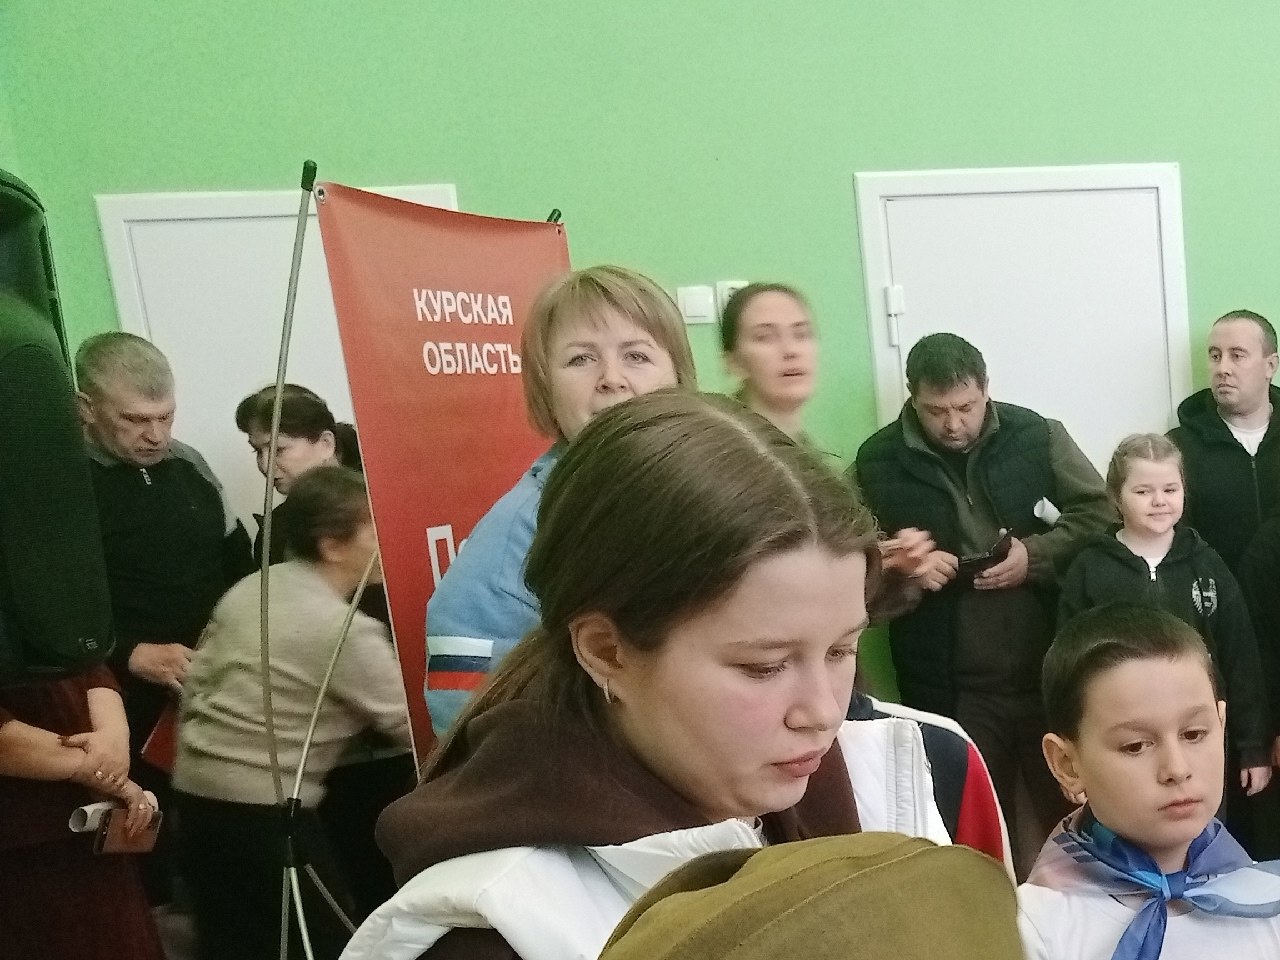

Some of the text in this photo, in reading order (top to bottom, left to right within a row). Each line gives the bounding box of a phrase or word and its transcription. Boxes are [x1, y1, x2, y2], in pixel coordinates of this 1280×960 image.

[413, 288, 514, 326] КУРСКАЯ
[423, 341, 522, 375] ОБЛАСТЬ
[426, 524, 468, 589] П
